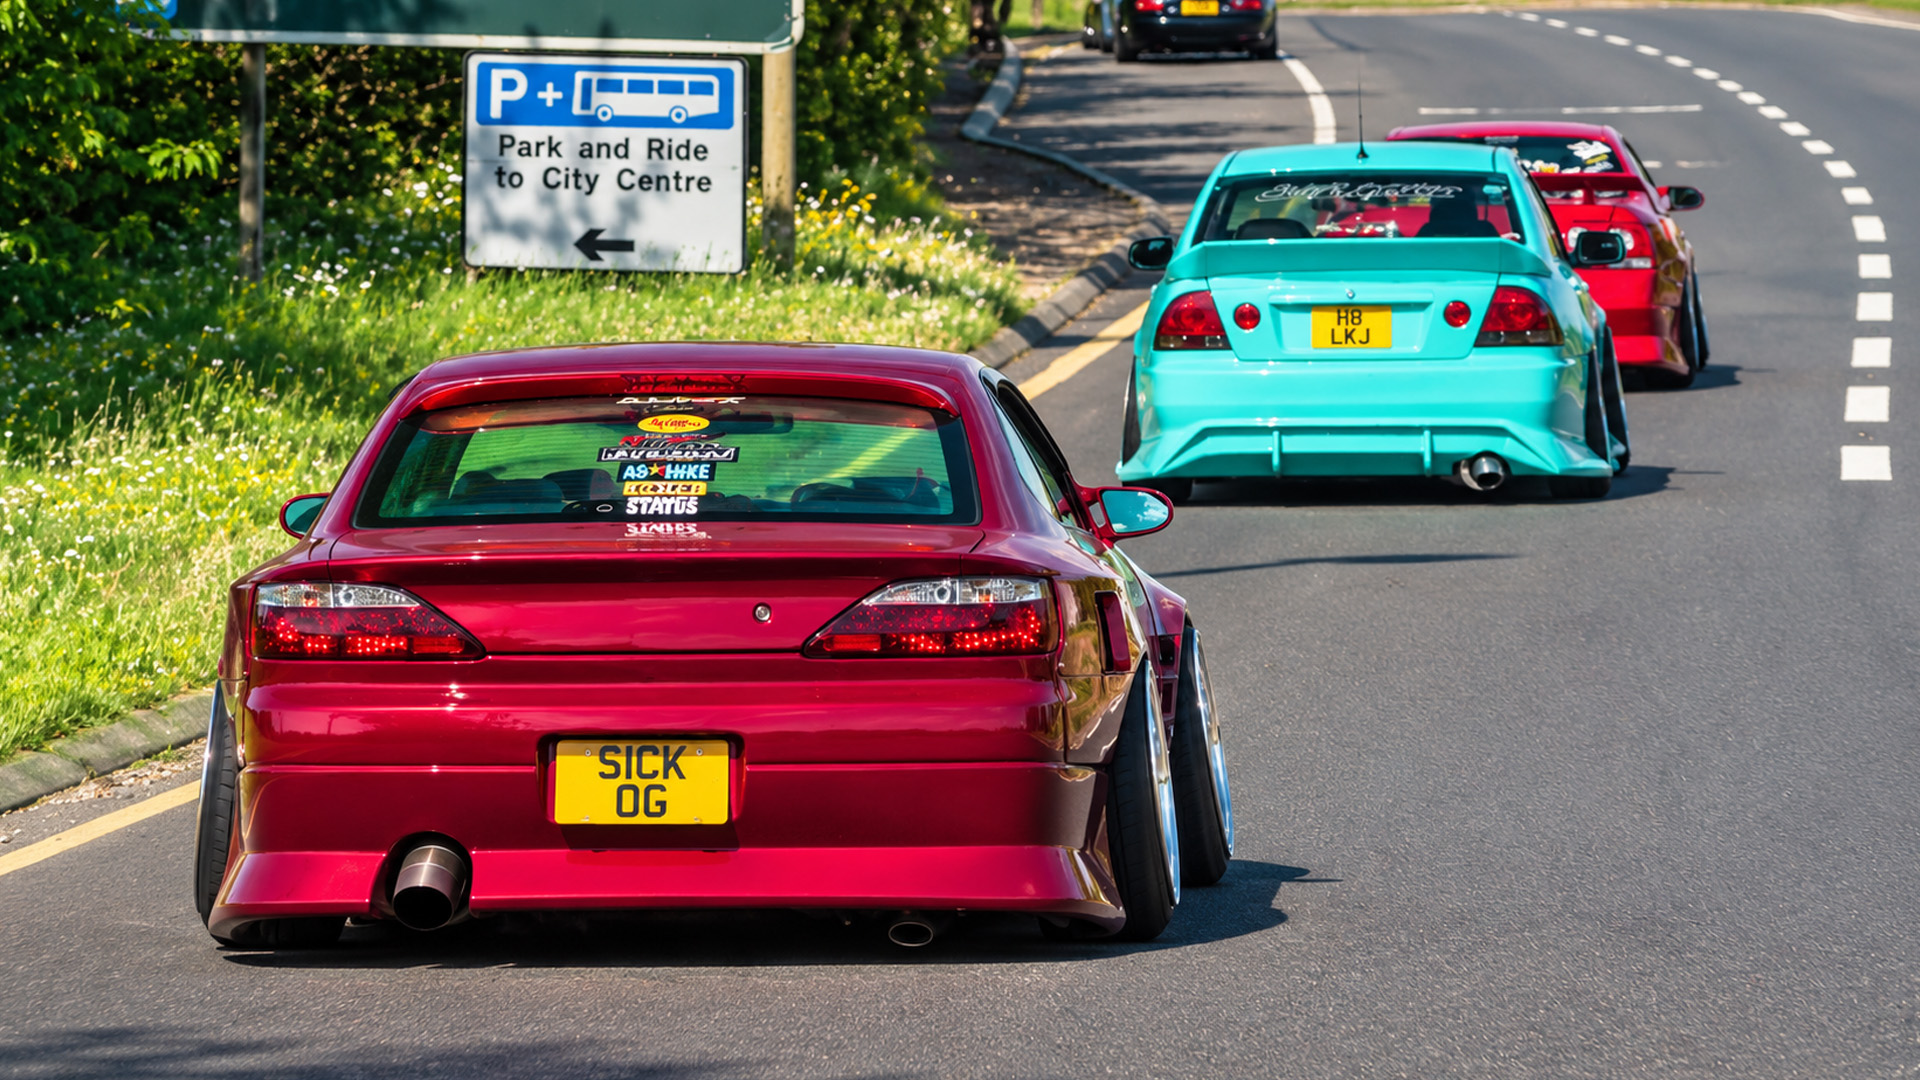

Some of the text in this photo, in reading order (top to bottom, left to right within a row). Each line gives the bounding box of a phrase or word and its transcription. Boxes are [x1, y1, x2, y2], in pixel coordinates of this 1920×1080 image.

[498, 133, 709, 162] Park and Ride
[494, 166, 713, 196] to City Centre
[1336, 308, 1363, 327] H8
[1330, 328, 1371, 346] LKJ
[626, 497, 698, 515] STATUS
[598, 744, 687, 780] SICK
[616, 783, 667, 818] OG
